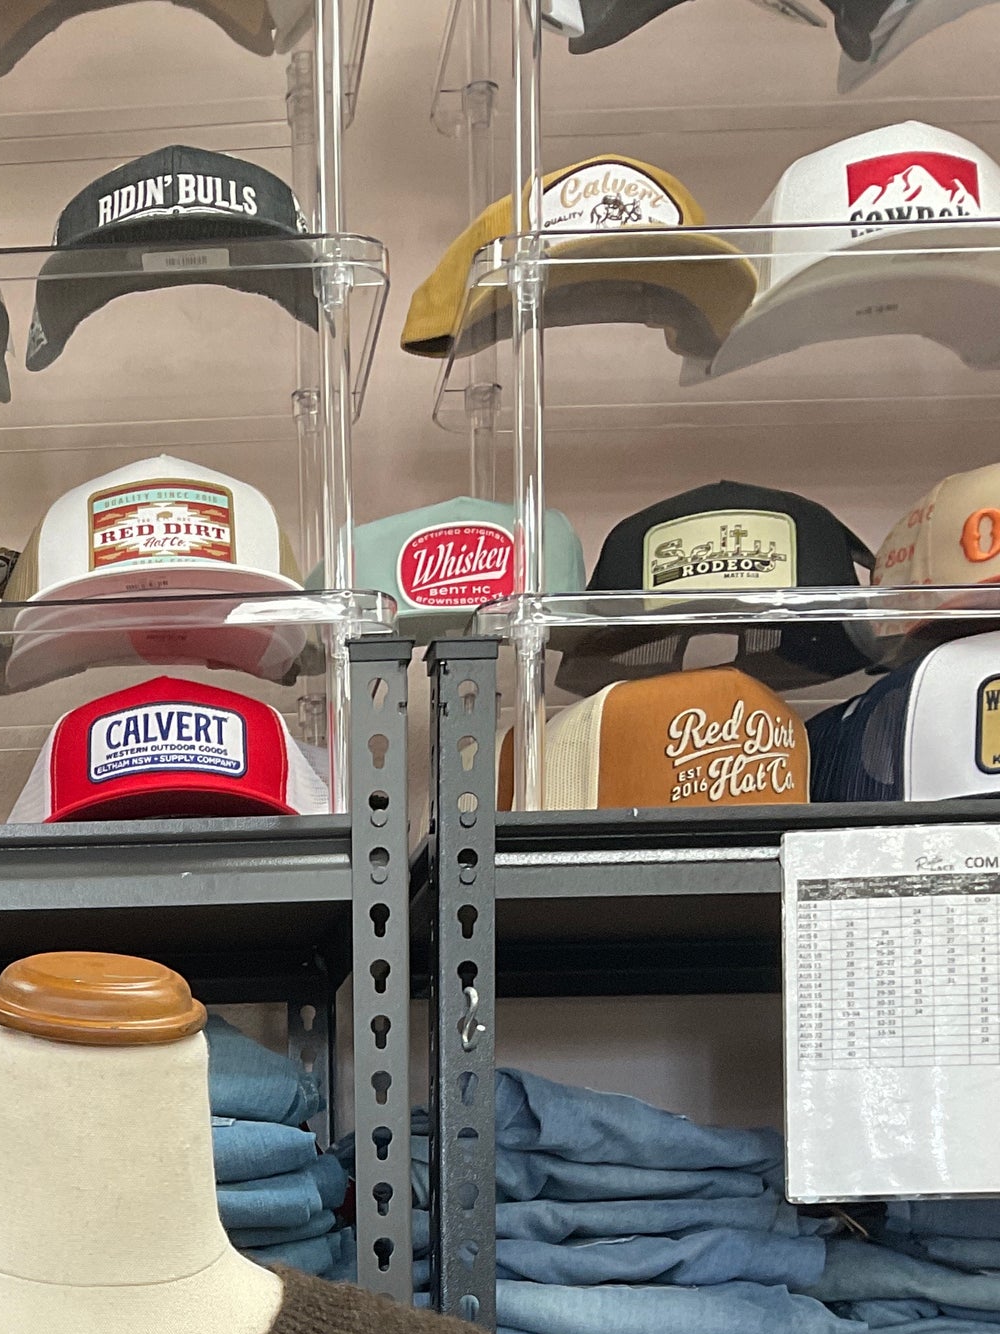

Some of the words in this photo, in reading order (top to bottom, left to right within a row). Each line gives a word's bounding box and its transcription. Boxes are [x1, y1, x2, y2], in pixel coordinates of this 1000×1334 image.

[177, 174, 258, 215] BULLS
[560, 171, 668, 209] Calvert
[544, 210, 584, 228] QUALITY
[100, 524, 155, 544] RED
[164, 523, 226, 540] DIRT
[411, 535, 511, 591] Whiskey
[682, 559, 752, 577] RODEO
[472, 585, 490, 594] HC
[106, 711, 229, 749] CALVERT
[666, 700, 744, 757] Red
[743, 710, 795, 755] Dirt
[106, 745, 148, 760] WESTERN
[150, 744, 196, 752] OUTDOOR
[198, 745, 228, 756] GOODS
[96, 760, 130, 775] ELTHAM
[132, 756, 152, 765] NSW
[159, 754, 195, 763] SUPPLY
[196, 756, 237, 769] COMPANY
[678, 766, 702, 782] EST
[708, 755, 767, 801] Hat
[766, 757, 795, 793] Co.
[671, 778, 707, 802] 2016
[965, 856, 1000, 869] COM
